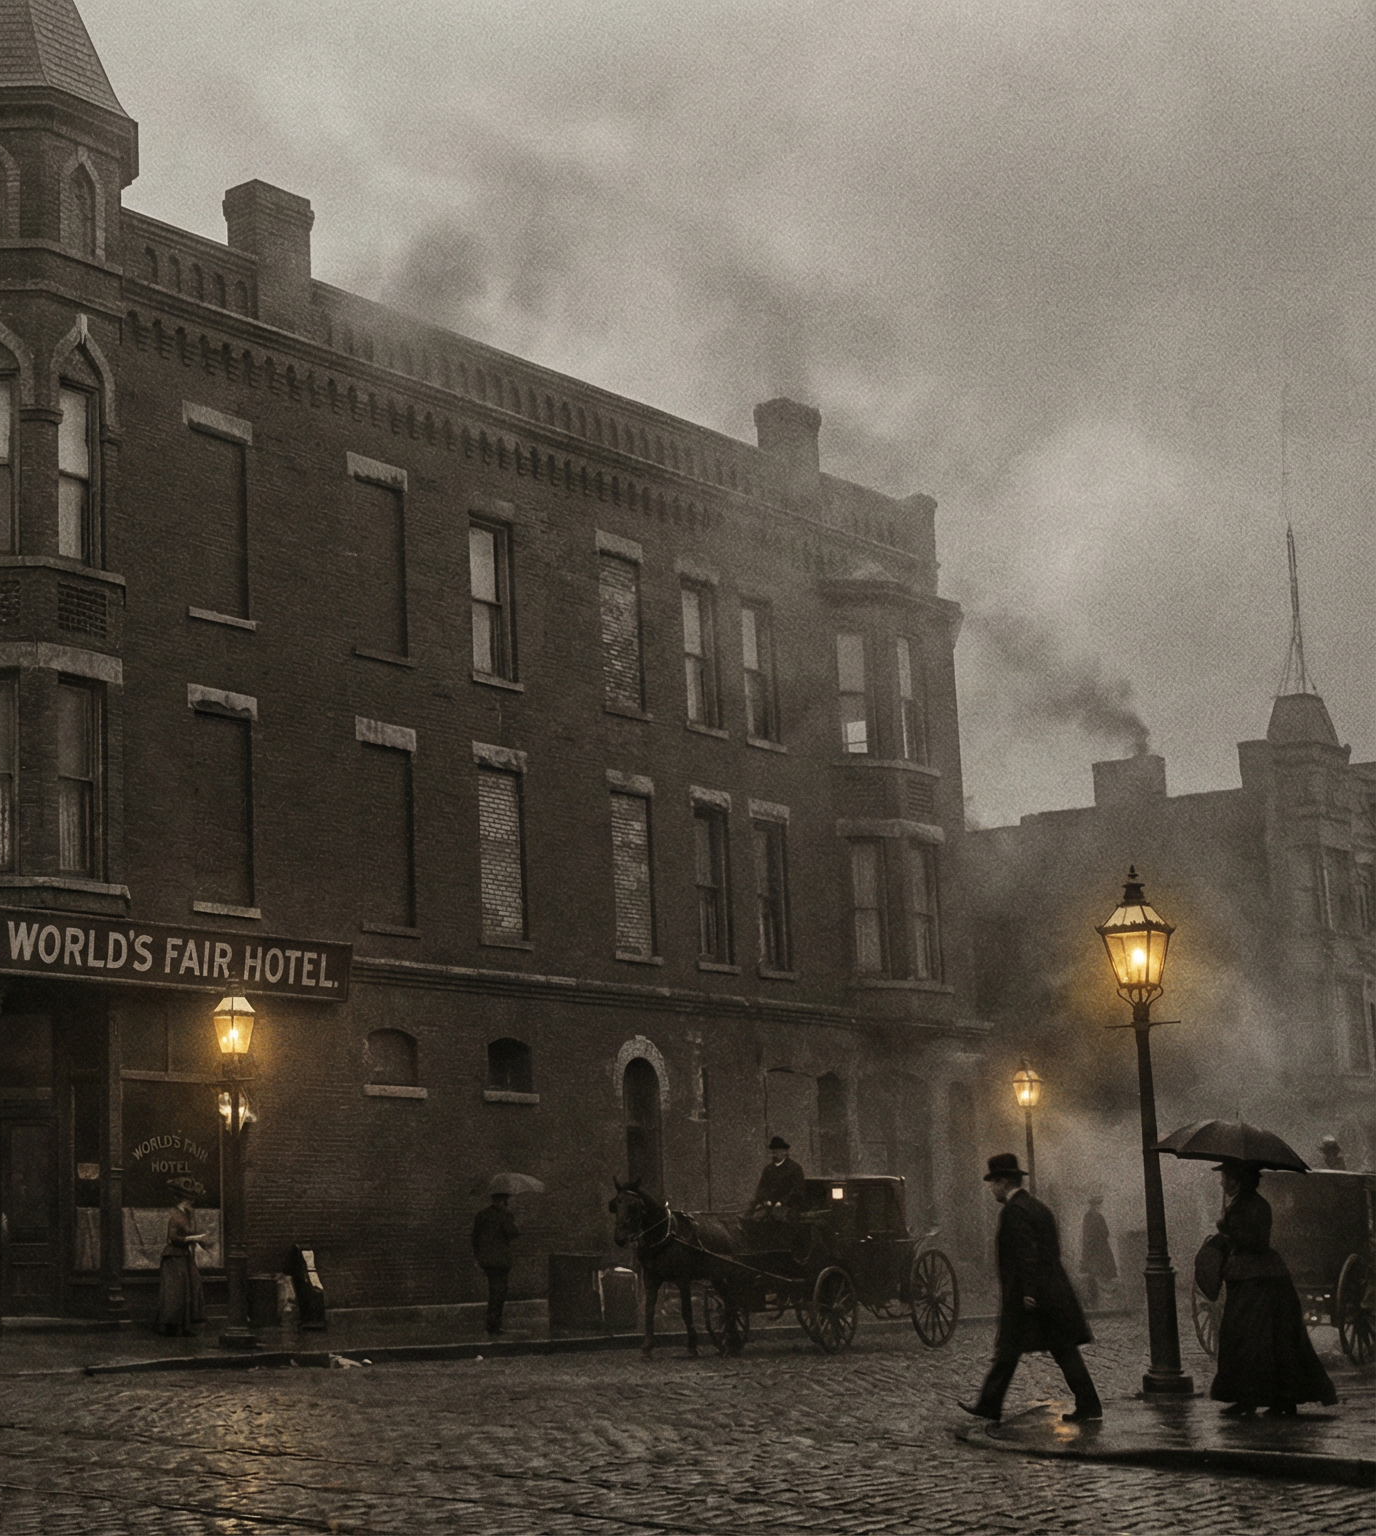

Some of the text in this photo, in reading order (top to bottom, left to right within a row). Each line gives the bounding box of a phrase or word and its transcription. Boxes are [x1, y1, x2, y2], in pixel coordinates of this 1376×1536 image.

[7, 920, 154, 972] WORLD'S
[164, 937, 234, 979] FAIR
[150, 1160, 191, 1174] HOTEL
